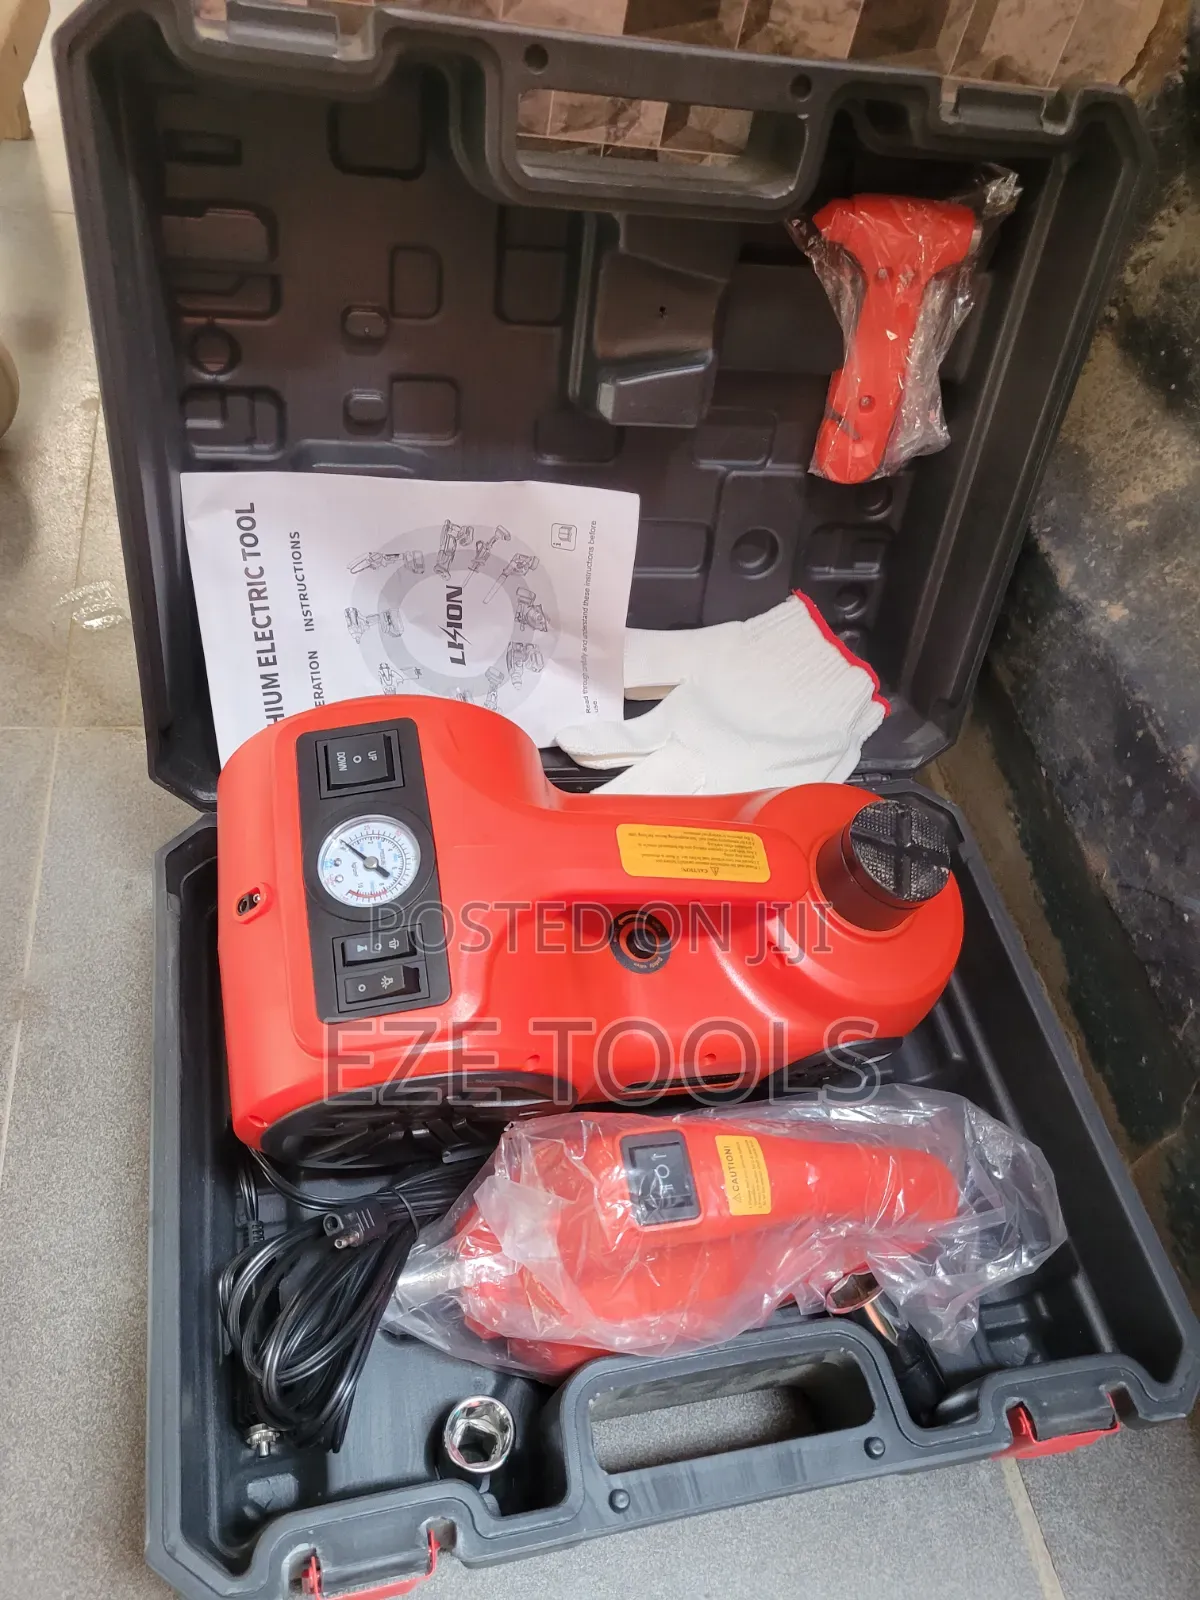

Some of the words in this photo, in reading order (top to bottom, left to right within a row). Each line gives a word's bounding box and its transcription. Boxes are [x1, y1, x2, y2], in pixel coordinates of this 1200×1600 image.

[235, 502, 262, 562] TOOL
[588, 520, 597, 545] before
[290, 531, 315, 632] INSTRUCTIONS
[584, 547, 594, 586] instructions
[244, 565, 278, 667] ELECTRIC
[260, 672, 285, 728] HIUM
[308, 650, 326, 708] ERATION
[336, 751, 348, 771] DOWN
[368, 751, 378, 761] UP
